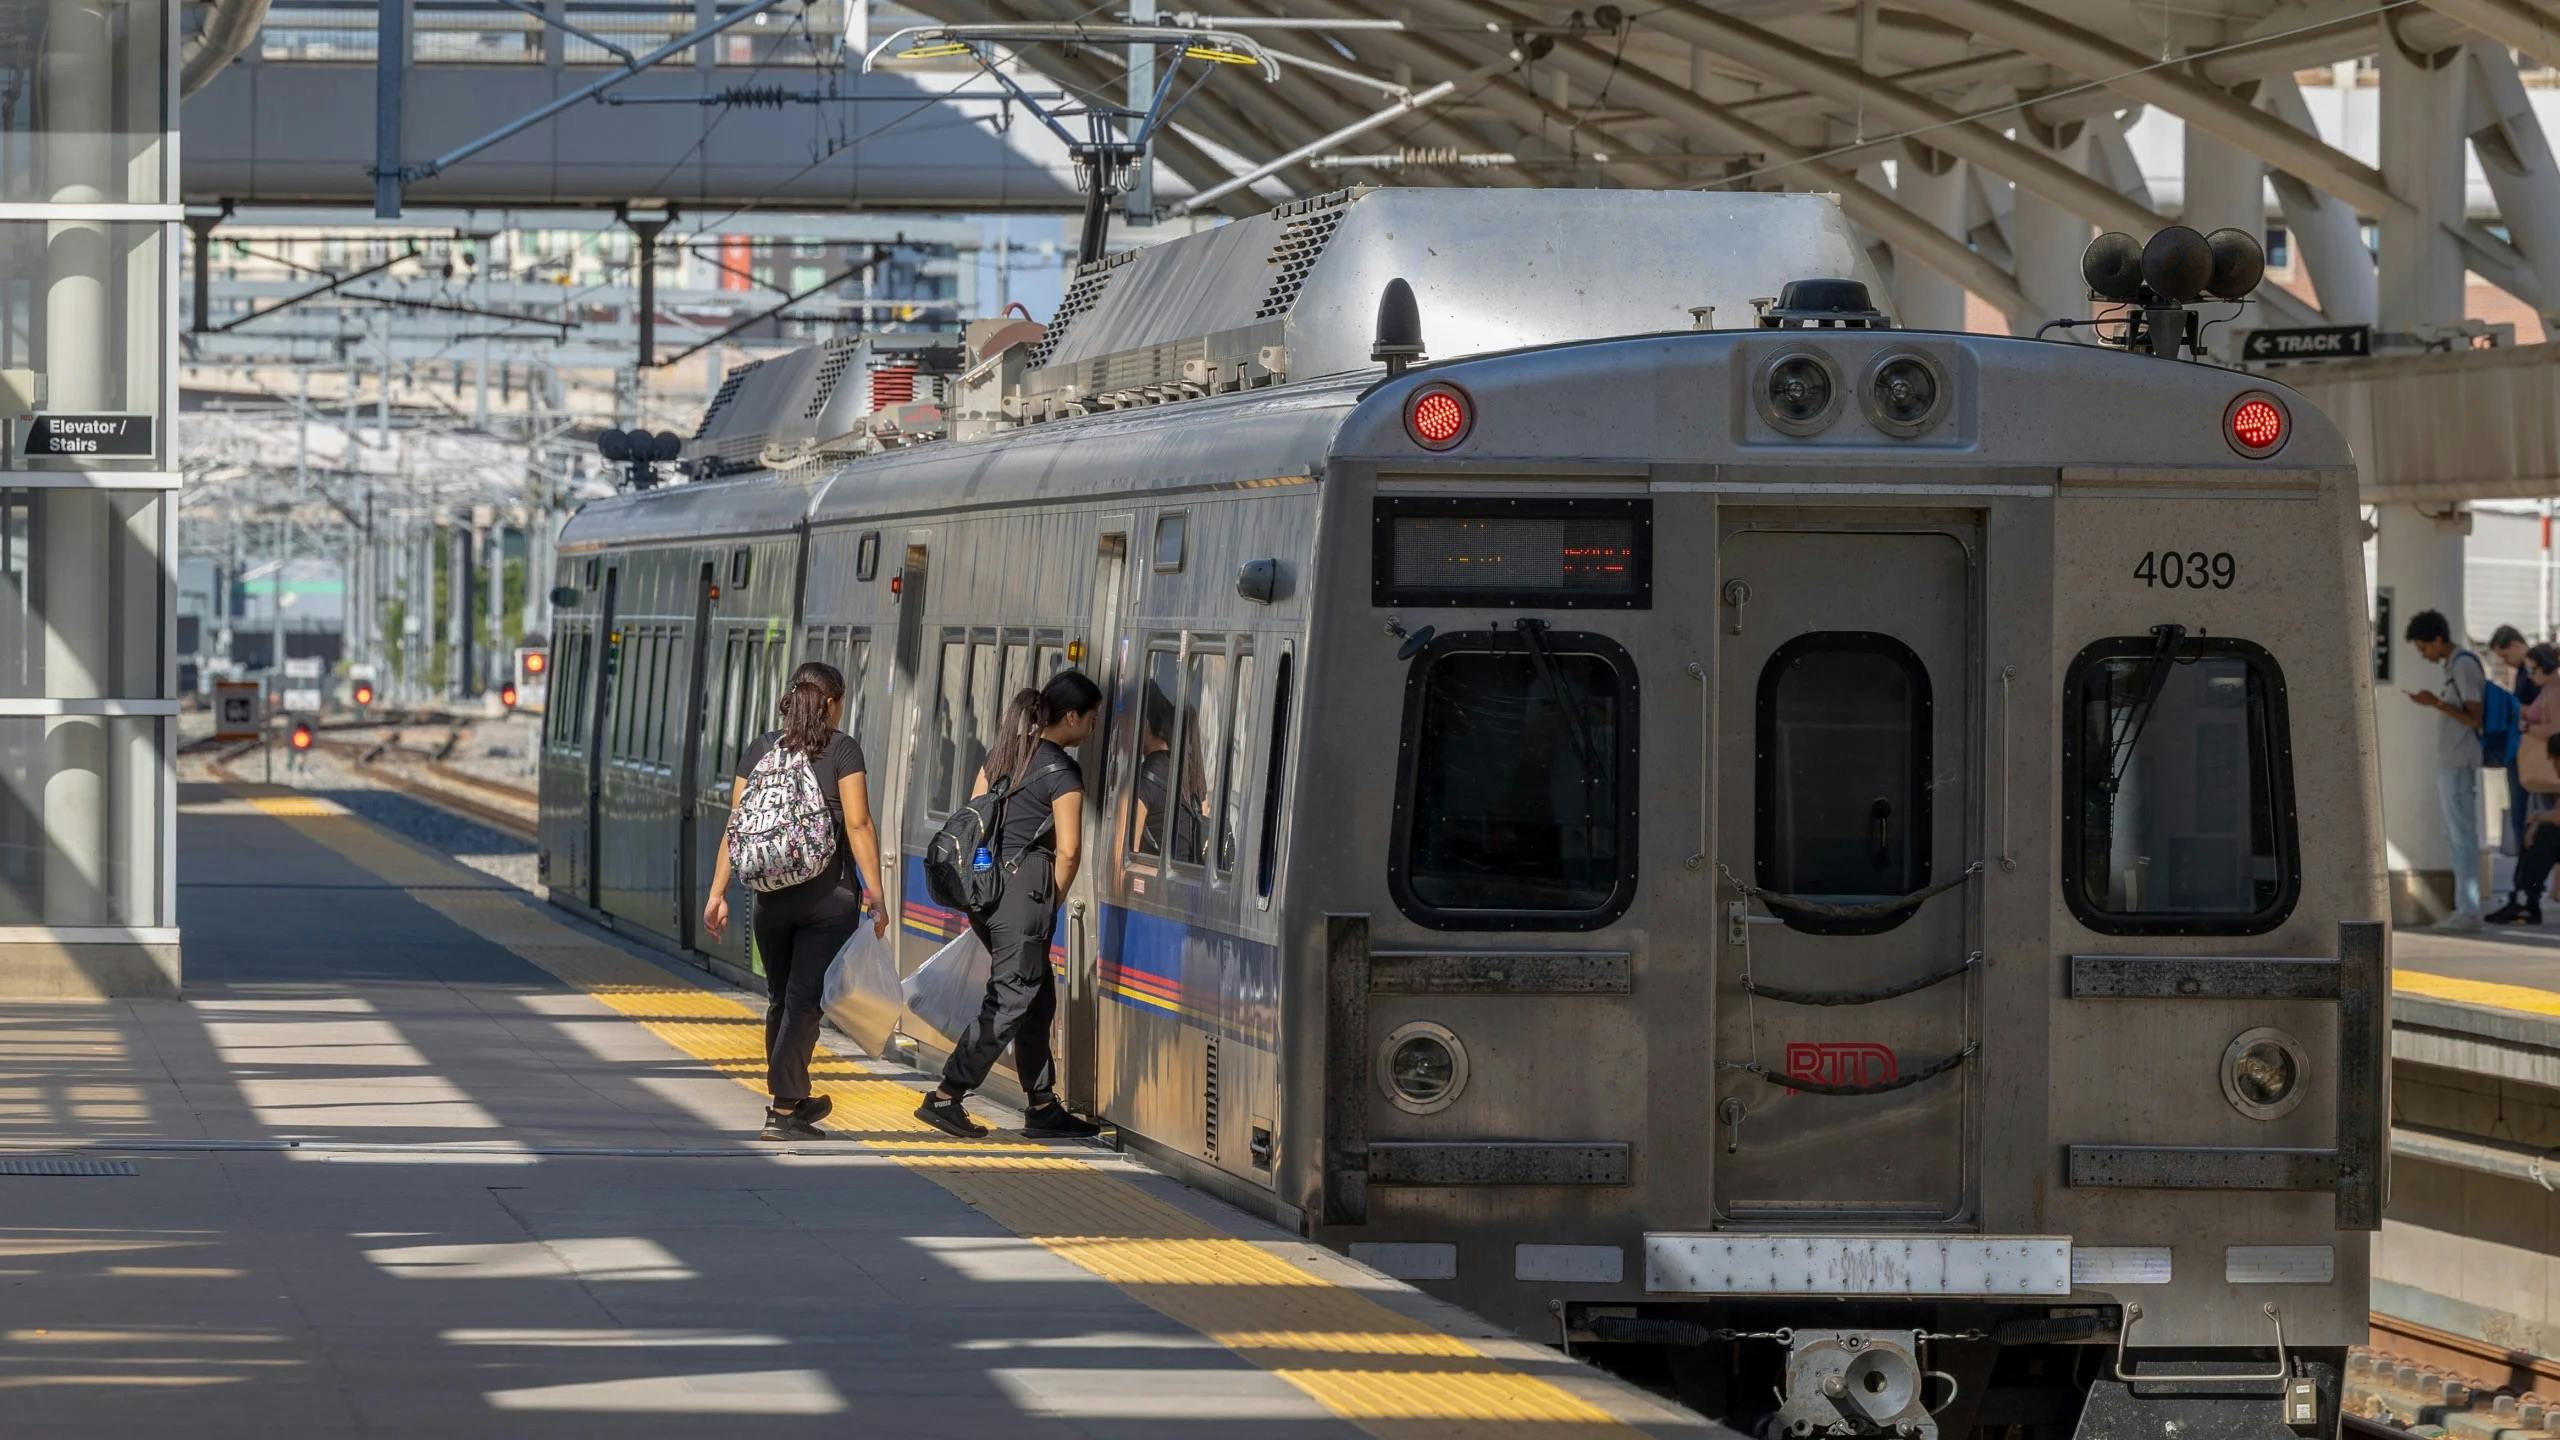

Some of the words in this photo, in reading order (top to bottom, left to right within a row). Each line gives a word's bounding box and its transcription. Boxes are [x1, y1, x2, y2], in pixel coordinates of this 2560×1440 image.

[2275, 333, 2342, 352] TRACK
[2350, 330, 2361, 352] 1
[49, 419, 117, 434] Elevator
[120, 419, 127, 436] /
[49, 437, 98, 452] Stairs
[2133, 551, 2236, 590] 4039
[1786, 1042, 1898, 1096] RTD
